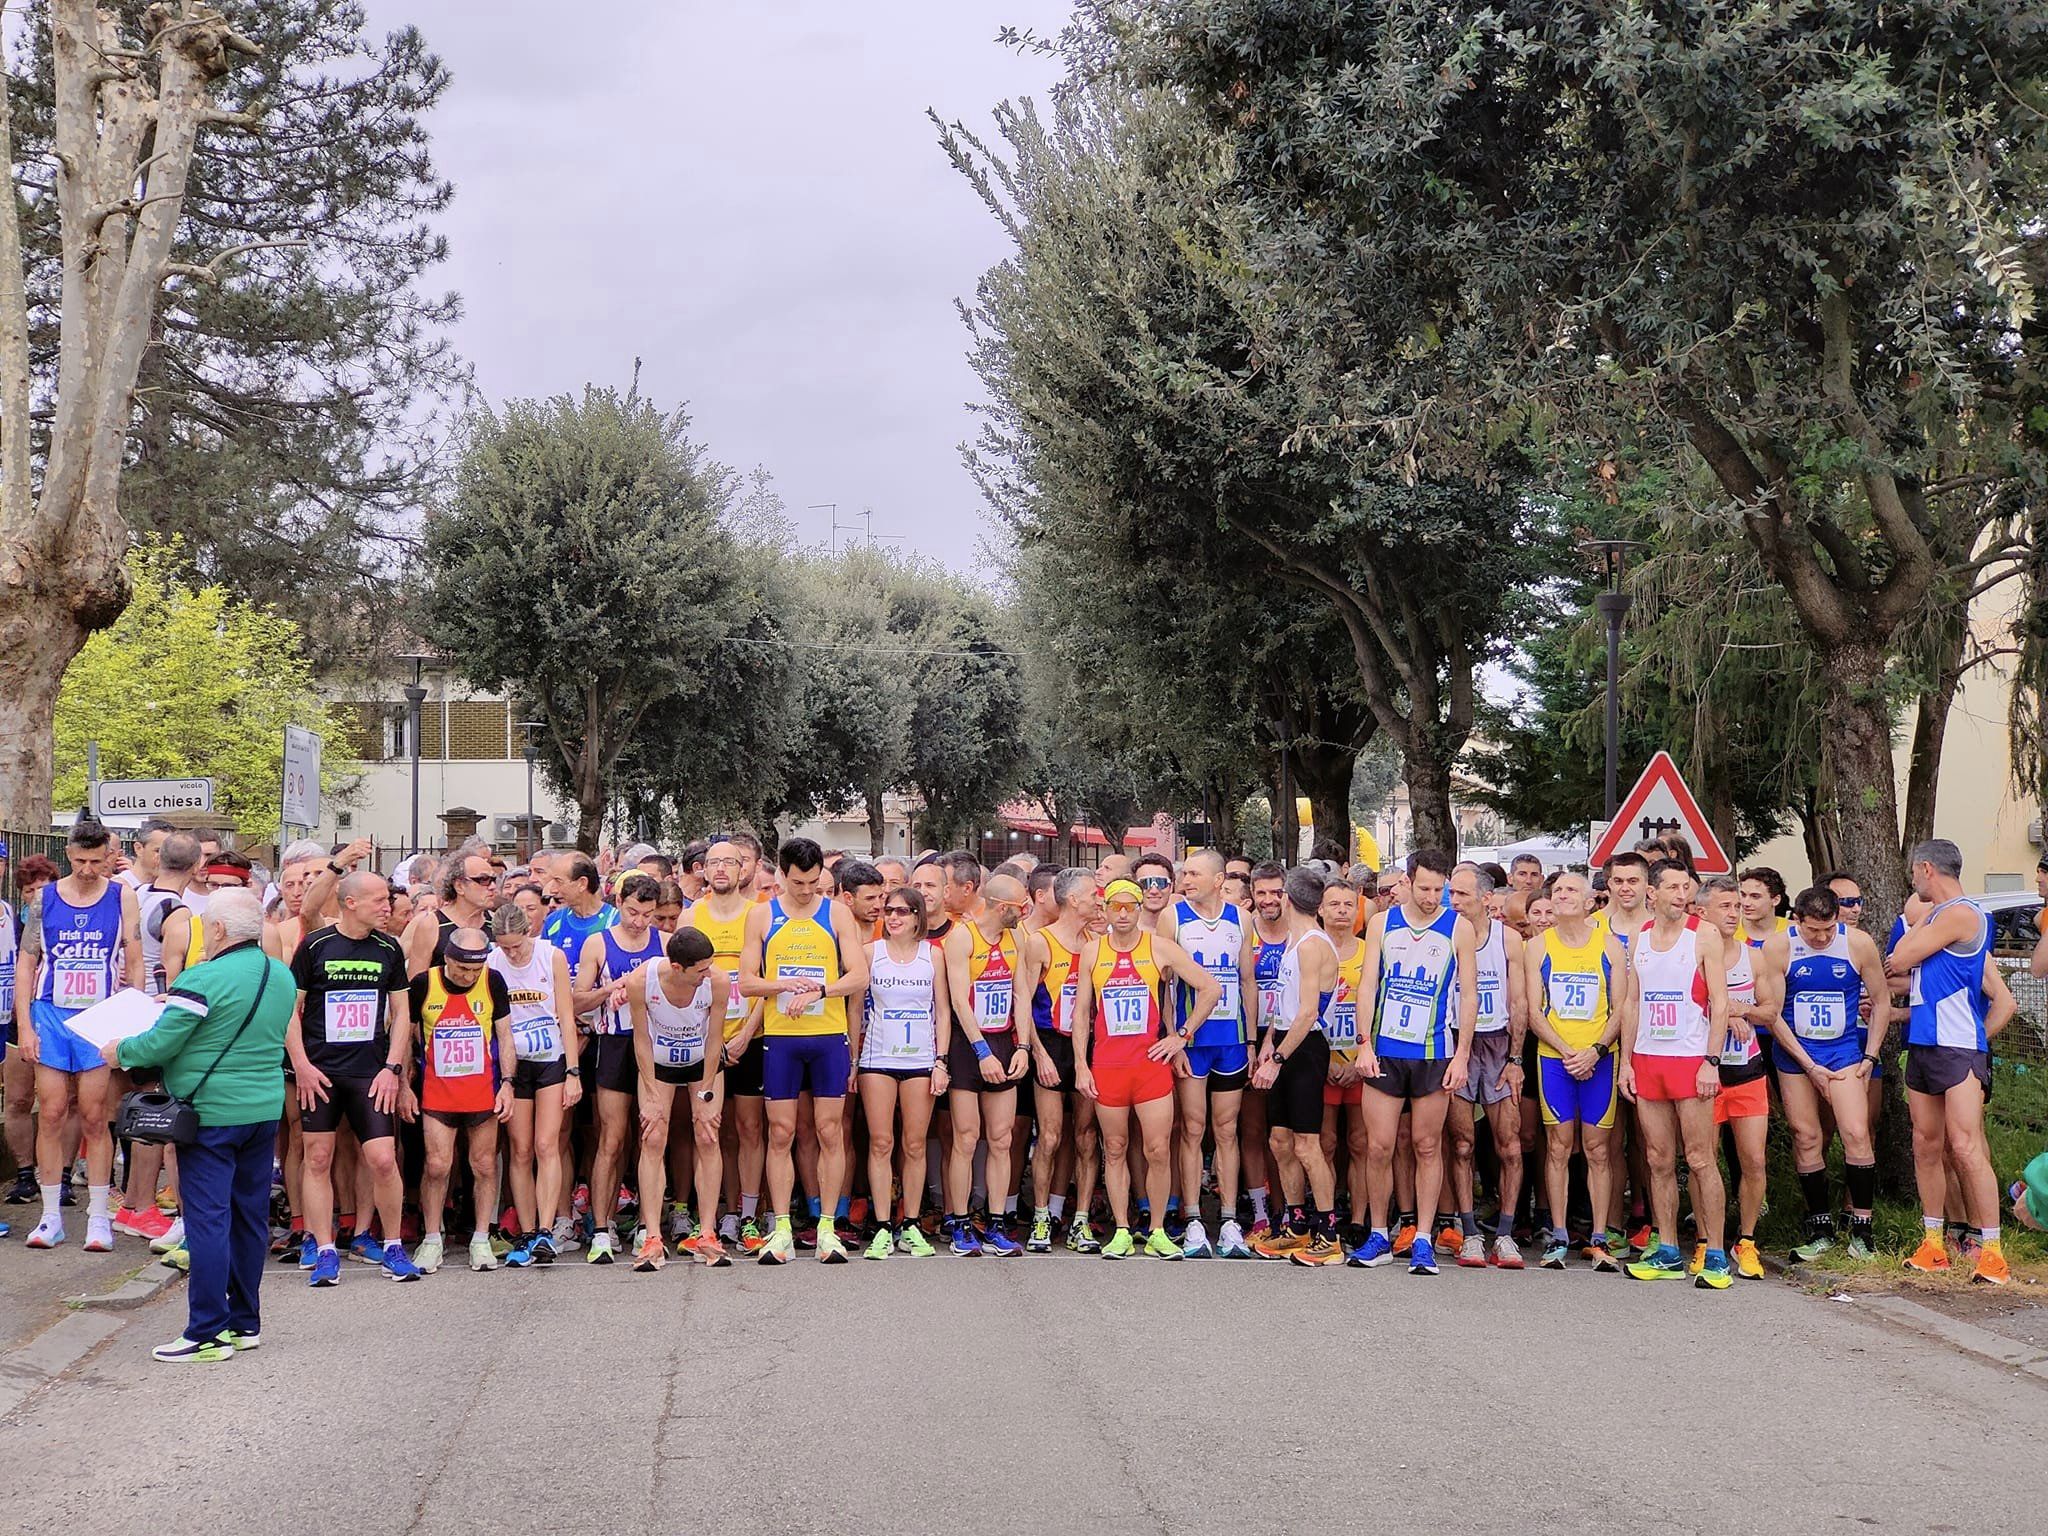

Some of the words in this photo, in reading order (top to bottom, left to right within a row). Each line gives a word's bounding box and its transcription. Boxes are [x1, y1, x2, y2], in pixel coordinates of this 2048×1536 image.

[179, 782, 203, 790] vicolo
[107, 795, 147, 809] della
[153, 794, 203, 808] chiesa
[59, 930, 81, 941] irish
[83, 930, 104, 942] pub
[51, 942, 109, 959] Celtic
[63, 971, 97, 995] 205
[327, 973, 379, 983] PONTELUNGO
[872, 976, 931, 988] lughesina
[984, 992, 1008, 1016] 195
[1564, 984, 1586, 1007] 25
[336, 1003, 370, 1029] 236
[1113, 998, 1142, 1022] 173
[1399, 1004, 1412, 1028] 9
[1649, 1003, 1677, 1027] 250
[1809, 1004, 1832, 1027] 35
[524, 1028, 553, 1053] 176
[903, 1021, 912, 1044] 1
[442, 1039, 475, 1065] 255
[669, 1047, 691, 1063] 60
